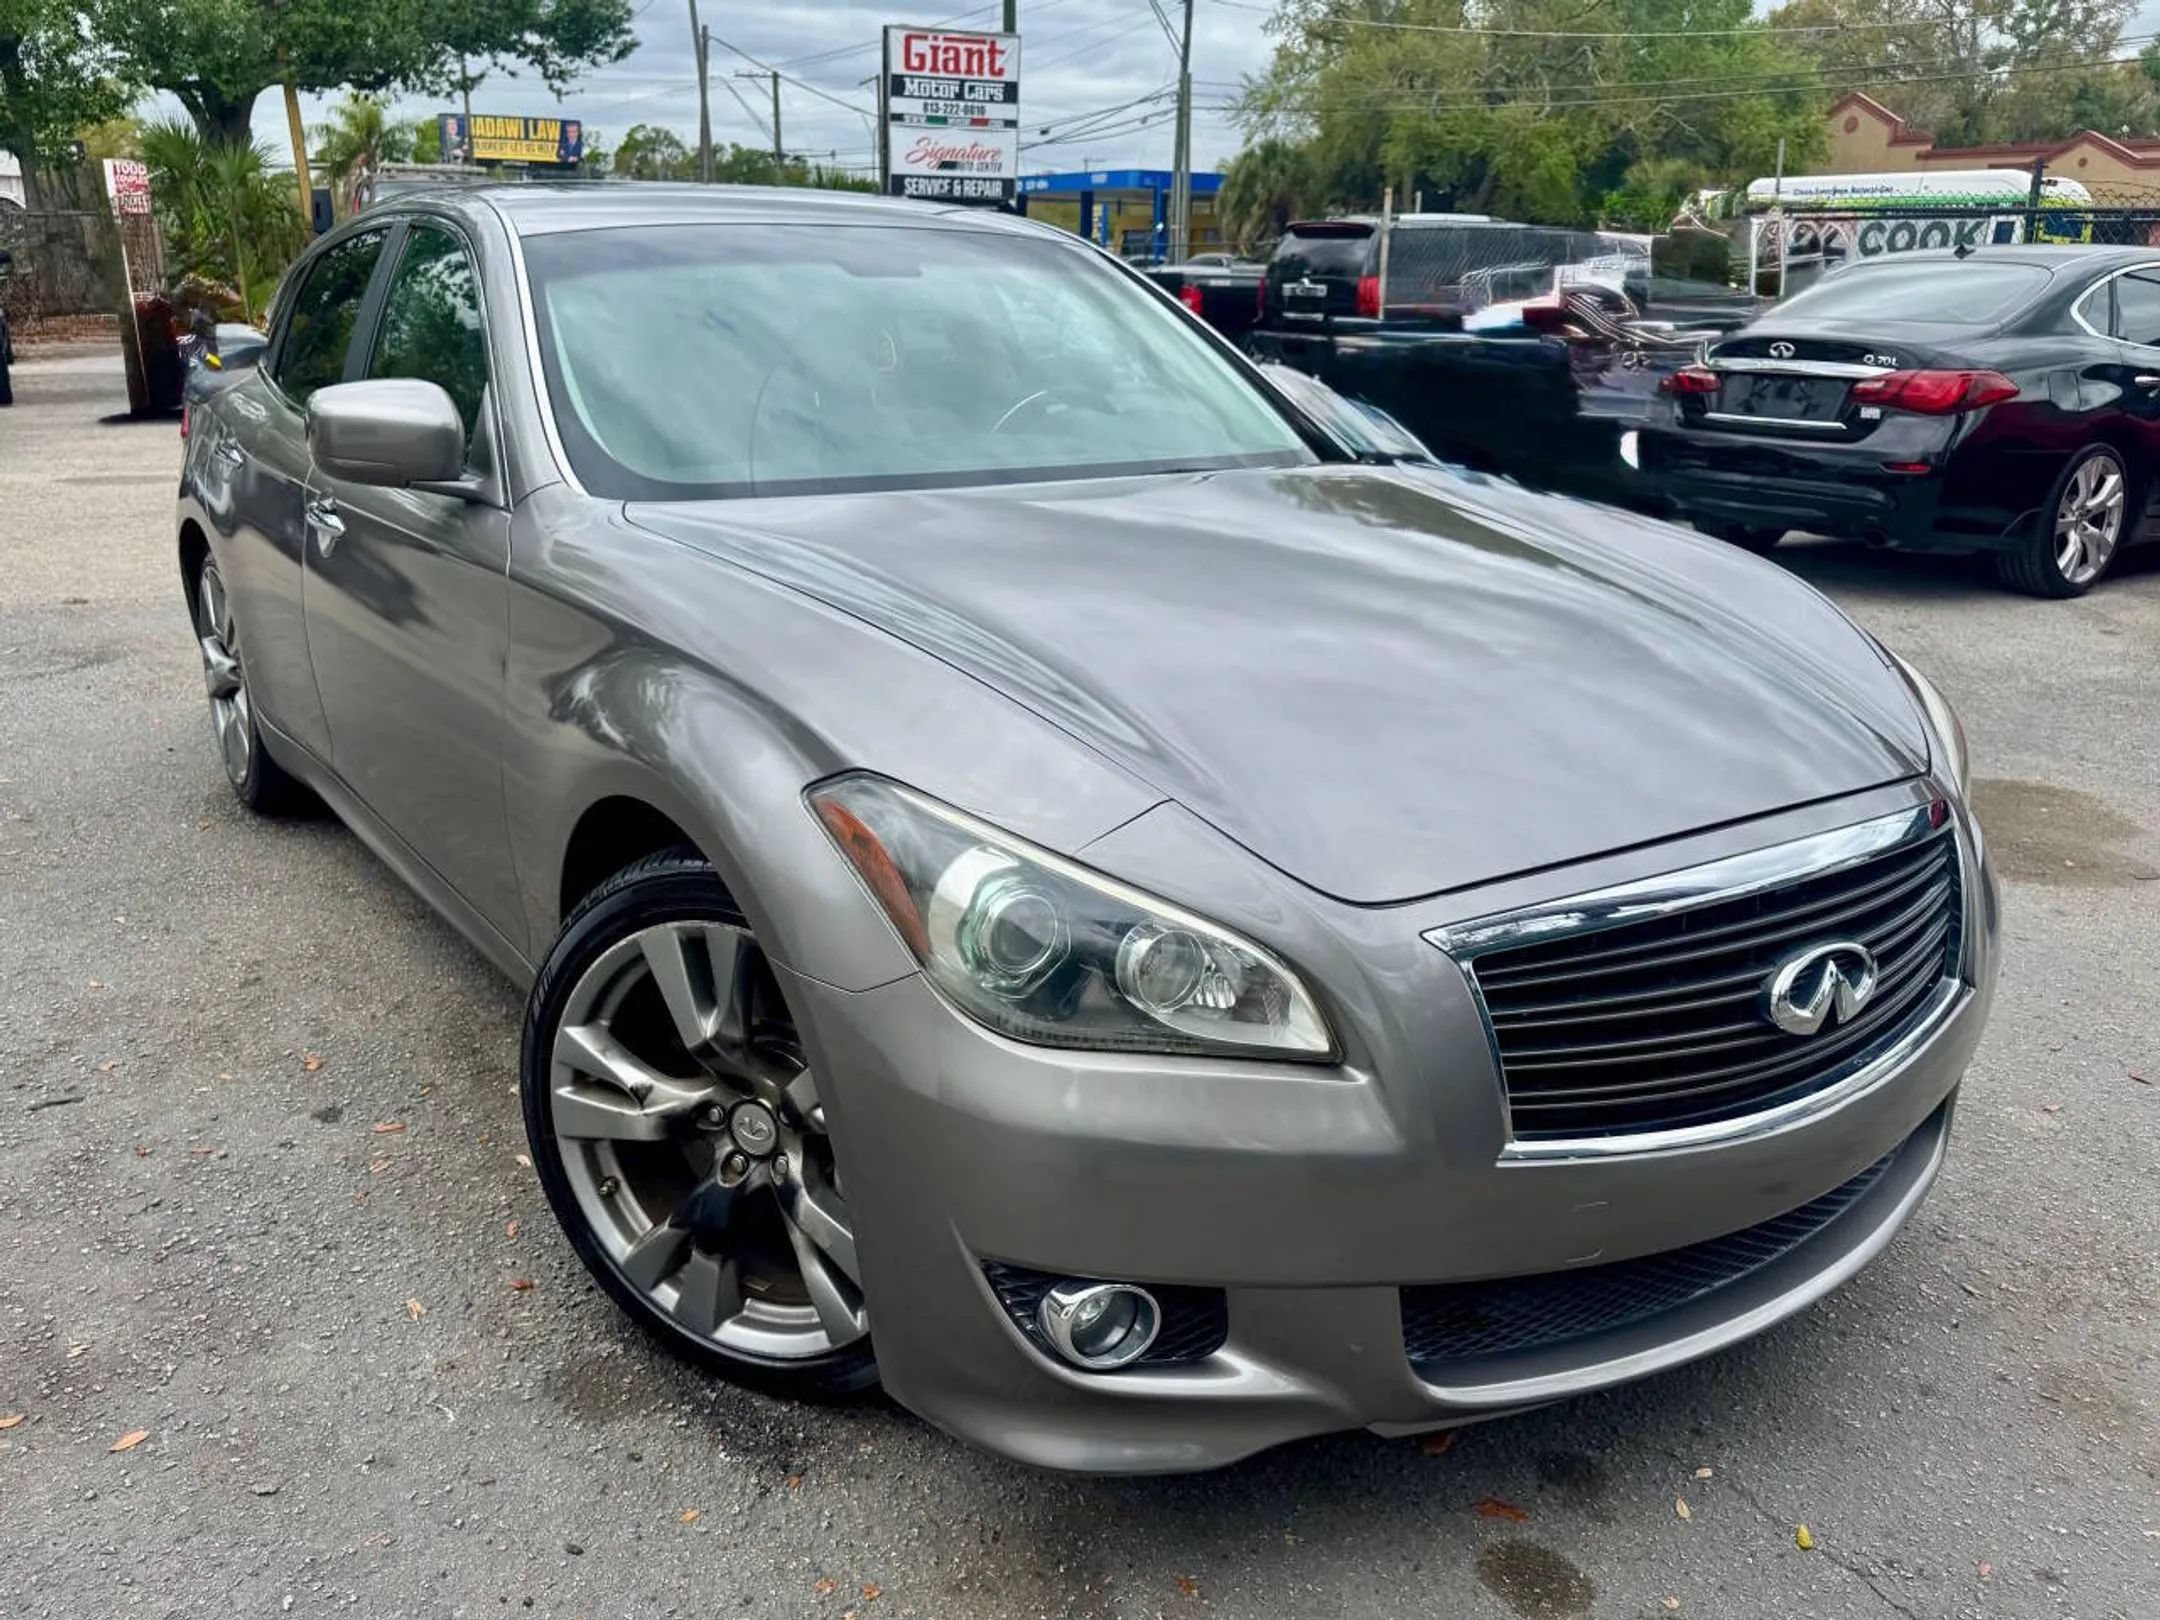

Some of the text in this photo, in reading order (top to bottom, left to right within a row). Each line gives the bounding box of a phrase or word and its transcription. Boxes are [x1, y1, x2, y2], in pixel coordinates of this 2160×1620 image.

[904, 33, 1006, 77] Giant
[903, 78, 1005, 102] Motor Cars
[528, 119, 561, 141] LAW
[904, 136, 1002, 171] Signature
[904, 177, 950, 195] SERVICE
[964, 180, 1003, 196] REPAIR
[1858, 221, 1987, 257] COOK
